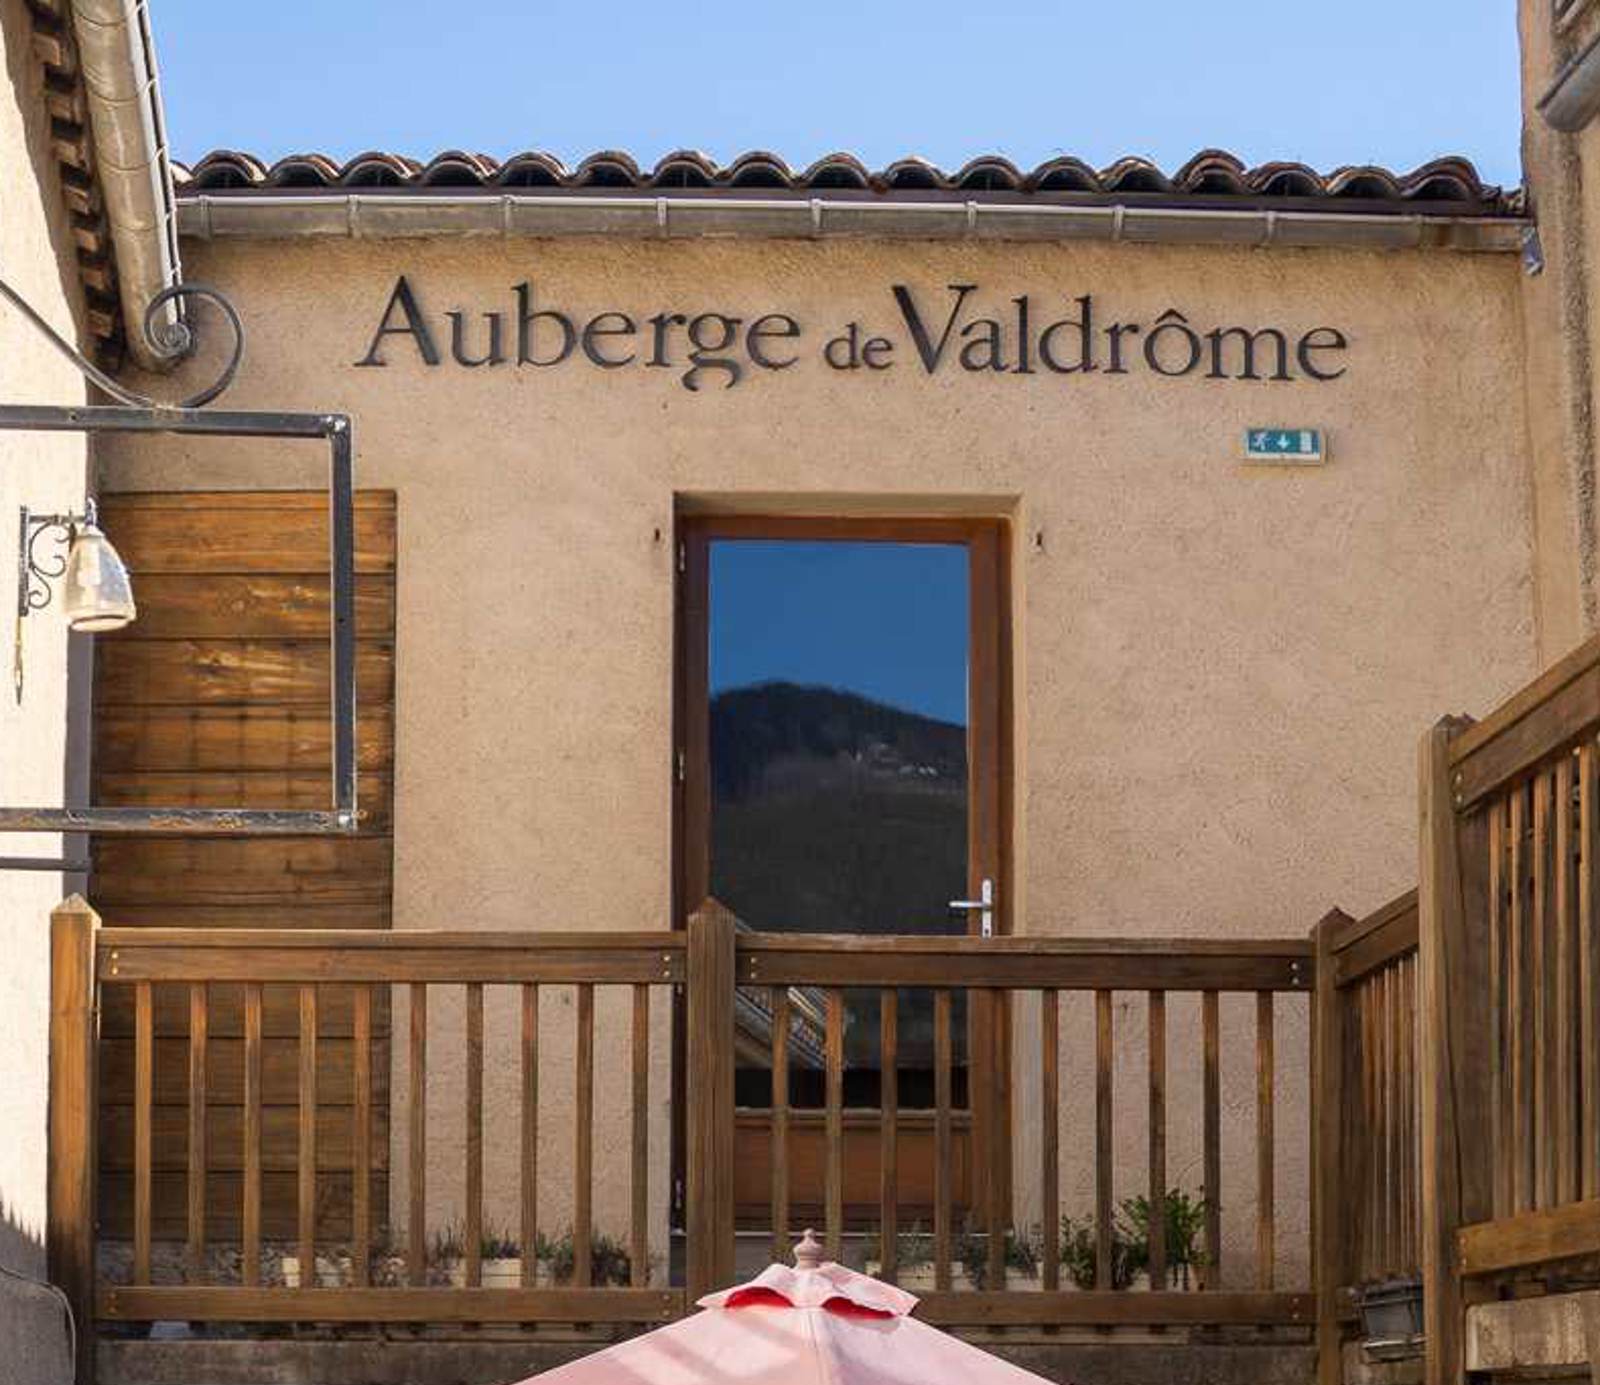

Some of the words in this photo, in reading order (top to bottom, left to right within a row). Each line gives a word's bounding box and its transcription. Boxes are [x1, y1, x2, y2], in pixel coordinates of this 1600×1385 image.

[353, 274, 801, 392] Auberge
[823, 321, 894, 371] de
[890, 283, 1348, 382] Valdrôme
